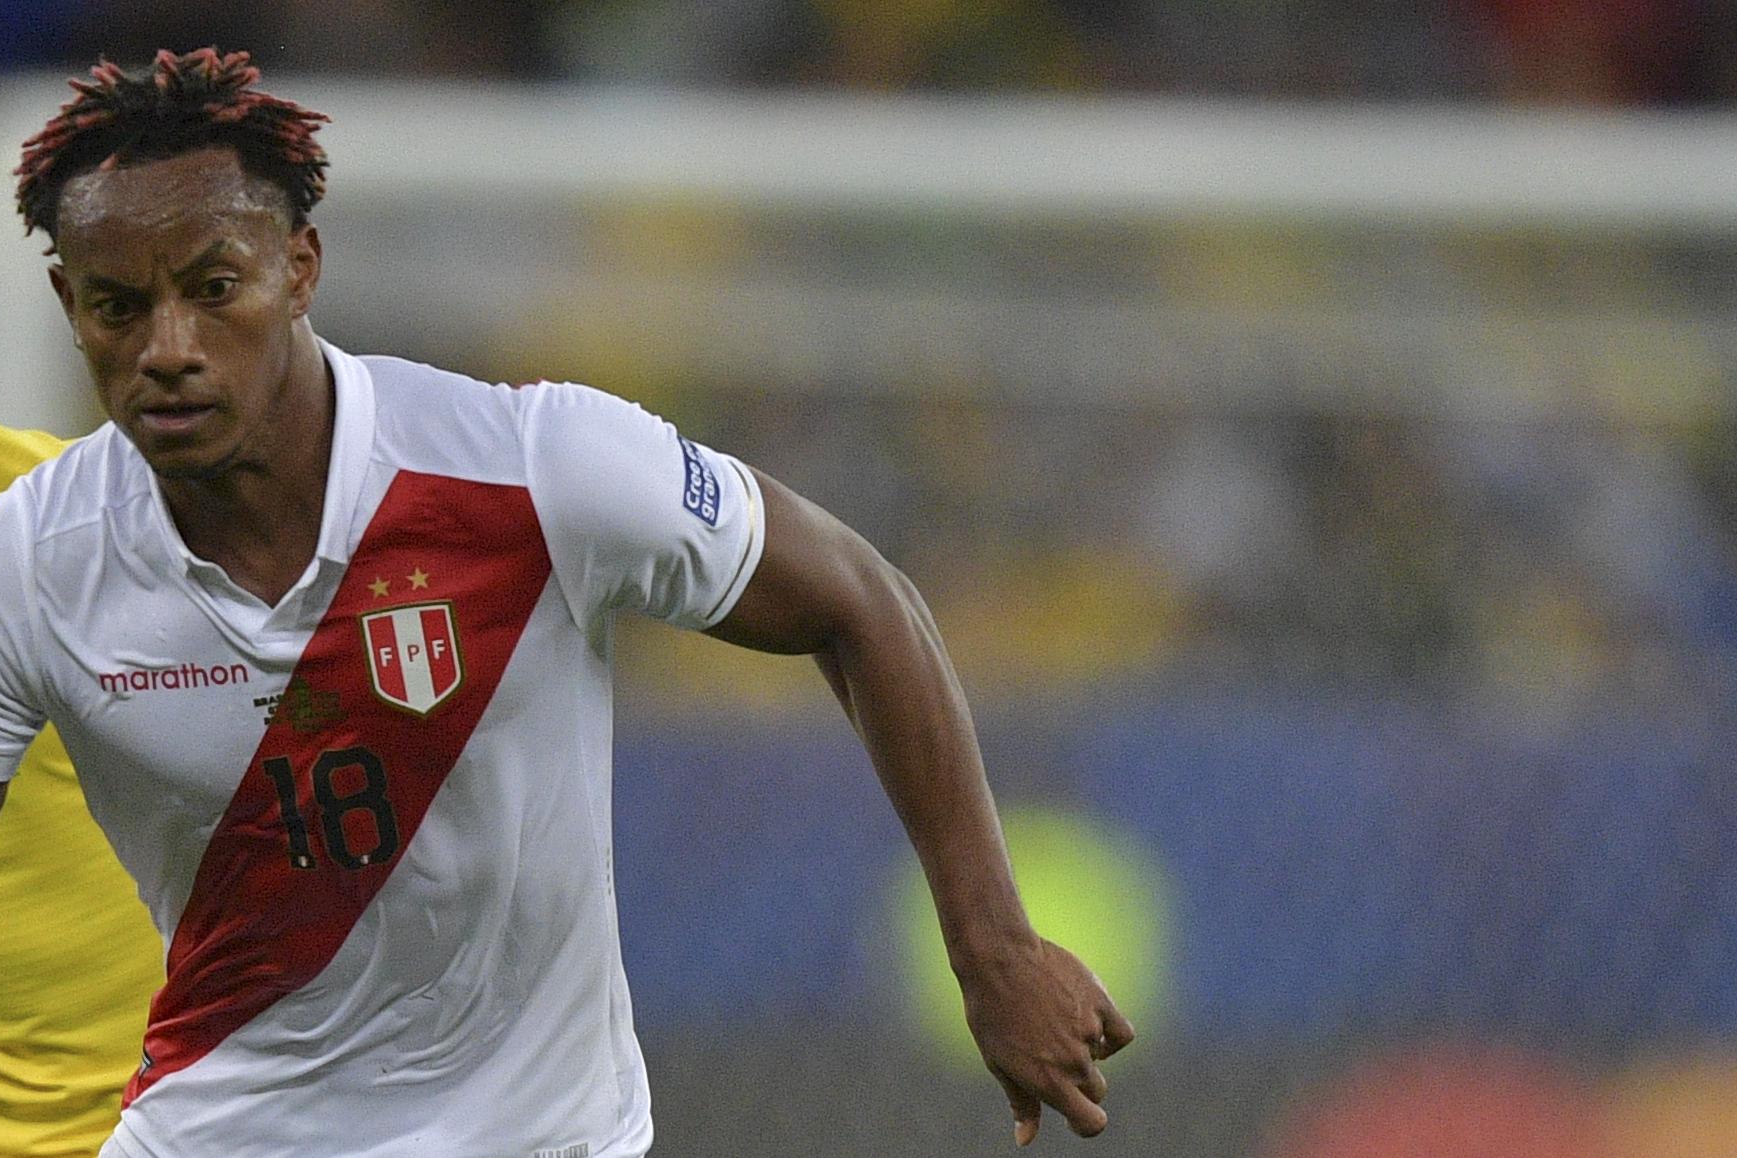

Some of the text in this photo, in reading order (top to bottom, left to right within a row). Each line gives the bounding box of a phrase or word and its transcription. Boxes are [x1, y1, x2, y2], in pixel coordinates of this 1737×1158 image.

[379, 639, 445, 668] FPF
[99, 663, 249, 693] marathon
[262, 746, 398, 870] 18
